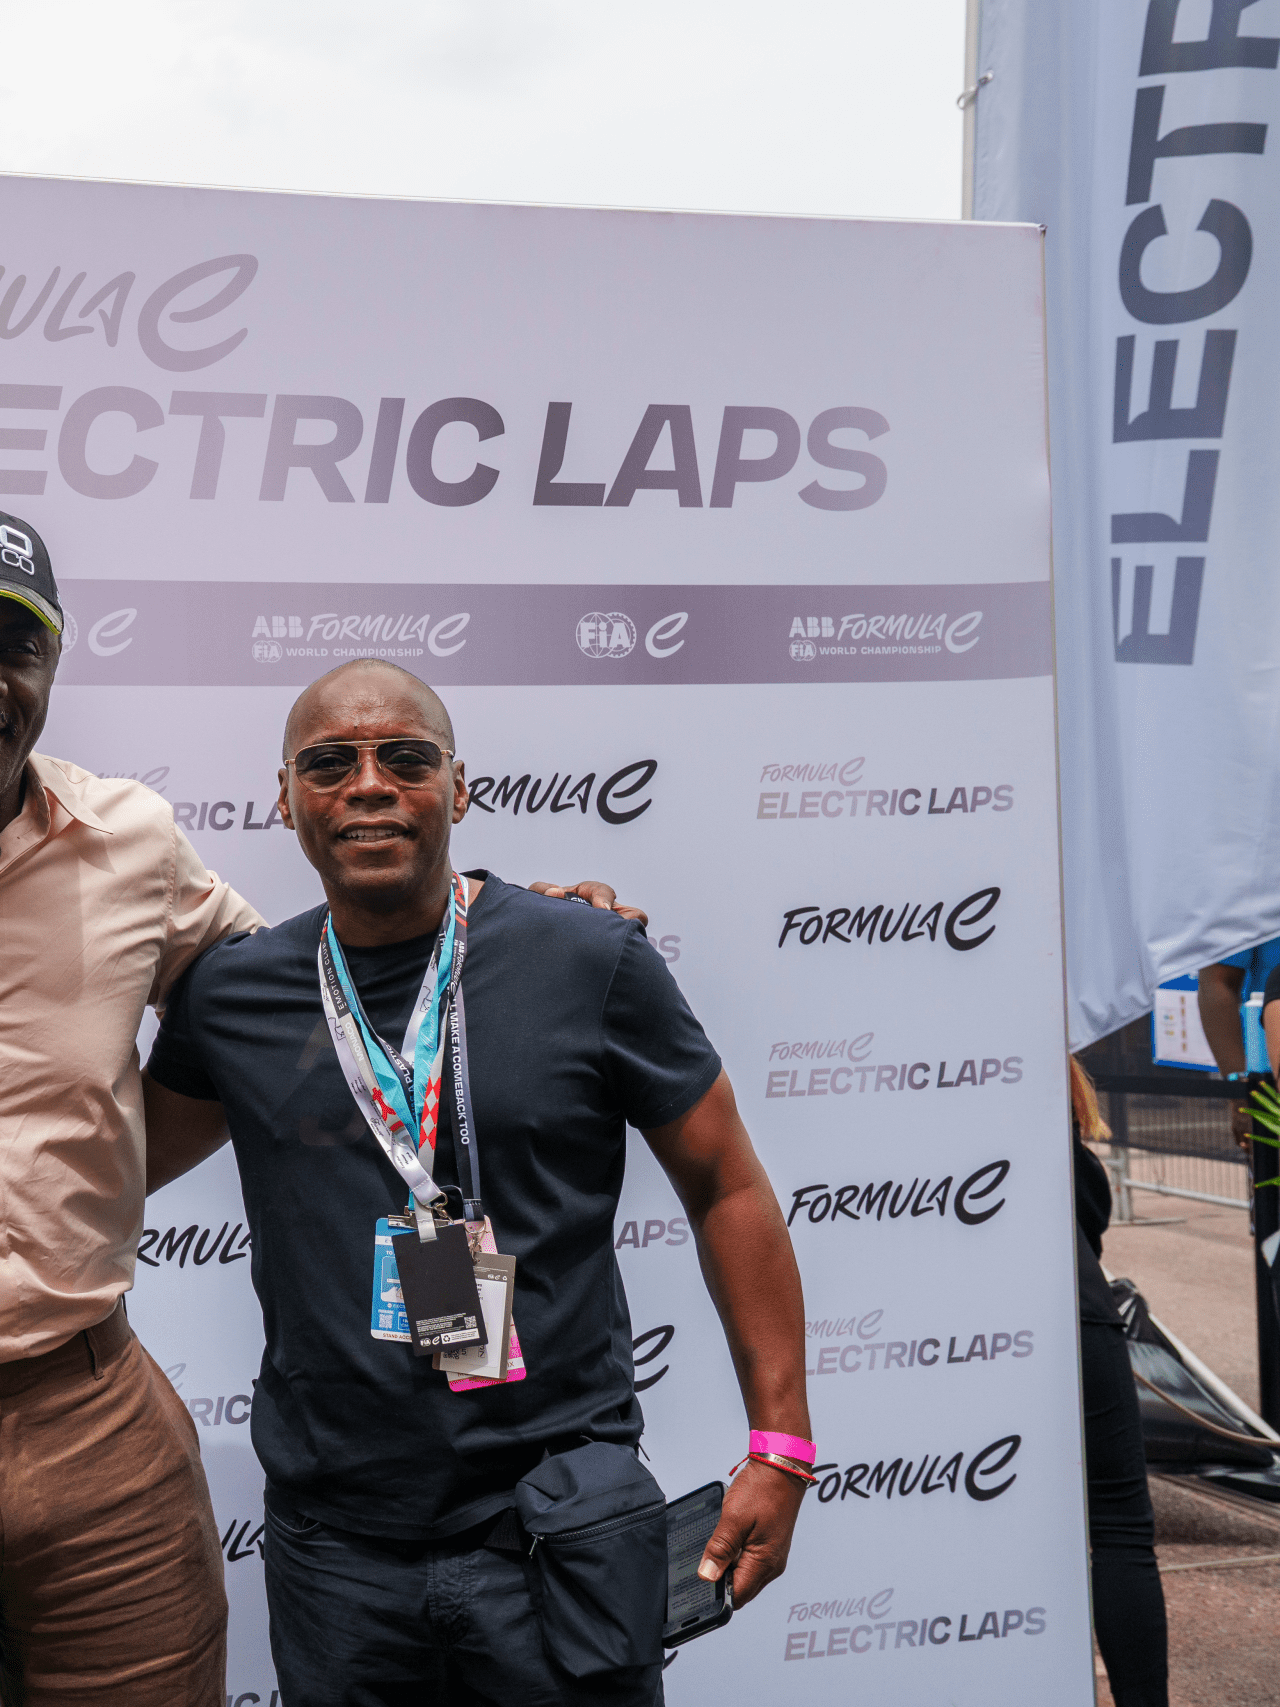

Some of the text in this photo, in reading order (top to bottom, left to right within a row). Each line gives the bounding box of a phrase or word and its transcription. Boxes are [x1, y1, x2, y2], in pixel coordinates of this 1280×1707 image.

[533, 401, 891, 512] LAPS
[251, 615, 304, 638] ABB
[306, 613, 429, 643] FORMULA
[789, 616, 835, 638] ABB
[837, 613, 947, 641] FORMULA
[285, 648, 328, 658] WORLD
[333, 648, 424, 658] CHAMPIONSHIP
[820, 646, 857, 655] WORLD
[861, 645, 942, 655] CHAMPIONSHIP
[760, 763, 838, 784] FORMULA
[466, 772, 590, 815] RMULA
[756, 784, 1014, 819] ELECTRIC LAPS
[242, 801, 287, 831] LA
[778, 901, 944, 949] FORMULA
[322, 942, 331, 966] CLUB
[345, 1021, 365, 1062] MONACO
[450, 1013, 459, 1045] MAKE
[452, 1046, 460, 1056] A
[769, 1039, 847, 1063] FORMULA
[452, 1055, 466, 1119] COMEBACK
[765, 1056, 1024, 1099] ELECTRIC LAPS
[459, 1120, 471, 1146] TOO
[787, 1175, 954, 1228] FORMULA
[137, 1221, 252, 1269] RMUL
[615, 1217, 689, 1250] APS
[805, 1315, 857, 1340] RMULA
[805, 1330, 1034, 1377] ECTRIC LAPS
[787, 1596, 868, 1624] FORMULA
[783, 1607, 1047, 1662] ELECTRIC LAPS
